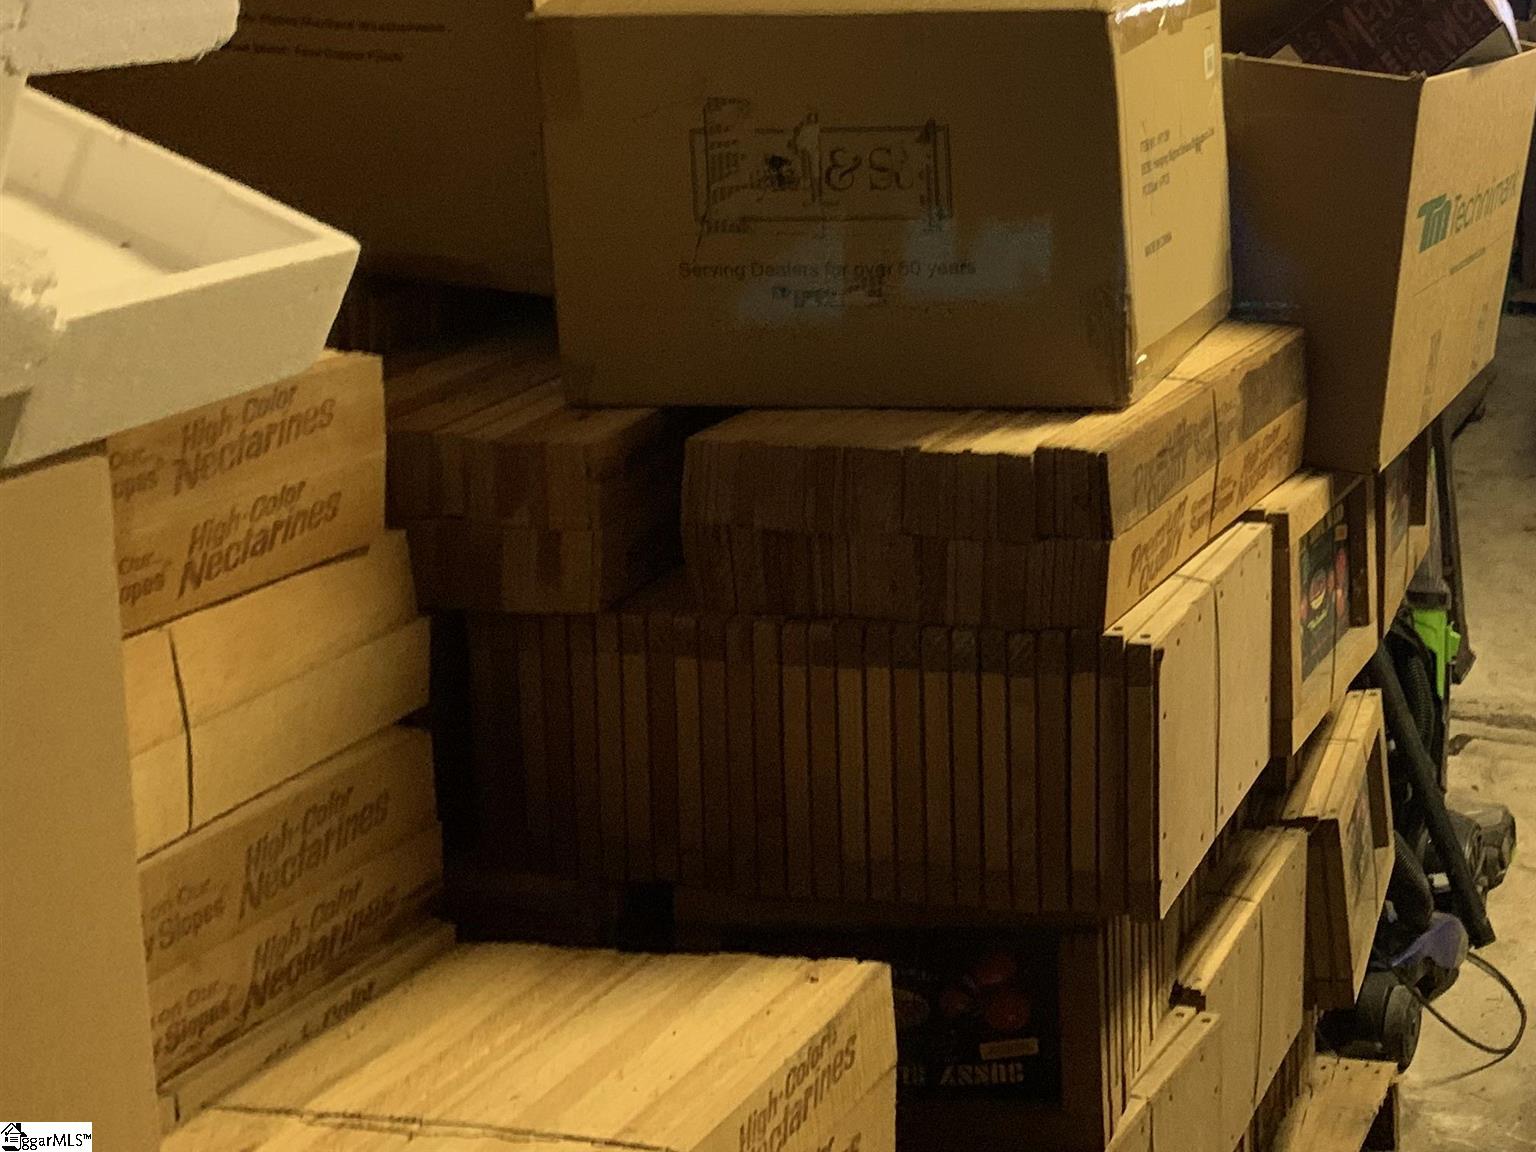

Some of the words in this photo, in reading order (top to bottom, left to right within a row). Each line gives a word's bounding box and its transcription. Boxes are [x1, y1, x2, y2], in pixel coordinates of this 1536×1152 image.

[172, 397, 337, 497] Nectarines
[178, 489, 342, 599] Nectarines
[239, 789, 391, 921] Nectarines
